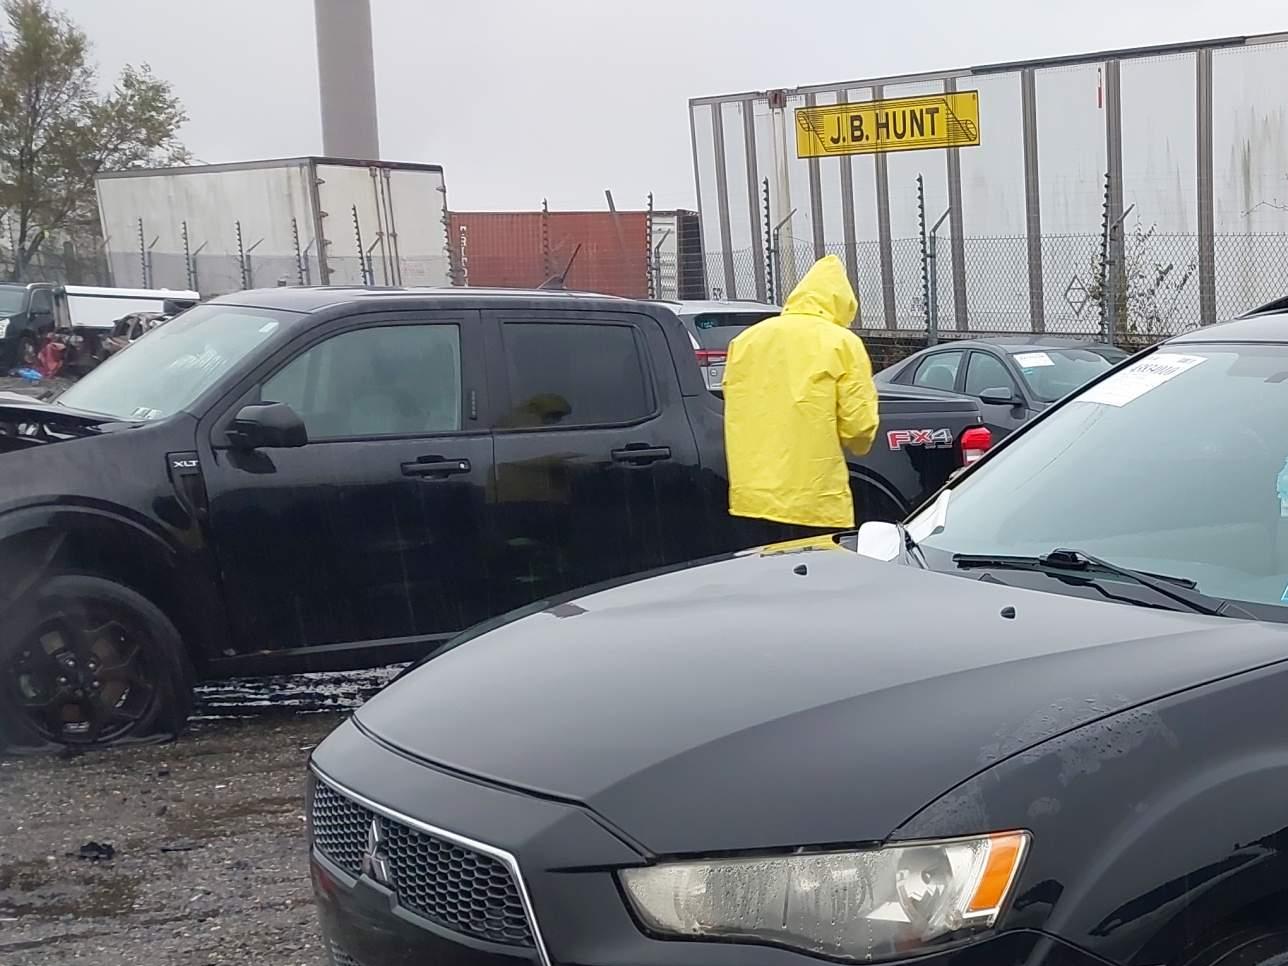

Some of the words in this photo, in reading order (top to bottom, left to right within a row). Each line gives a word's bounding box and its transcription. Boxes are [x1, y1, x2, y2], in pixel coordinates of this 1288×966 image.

[830, 114, 869, 144] J.B.
[875, 107, 940, 141] HUNT
[886, 428, 953, 451] FX4
[173, 460, 199, 468] XLT
